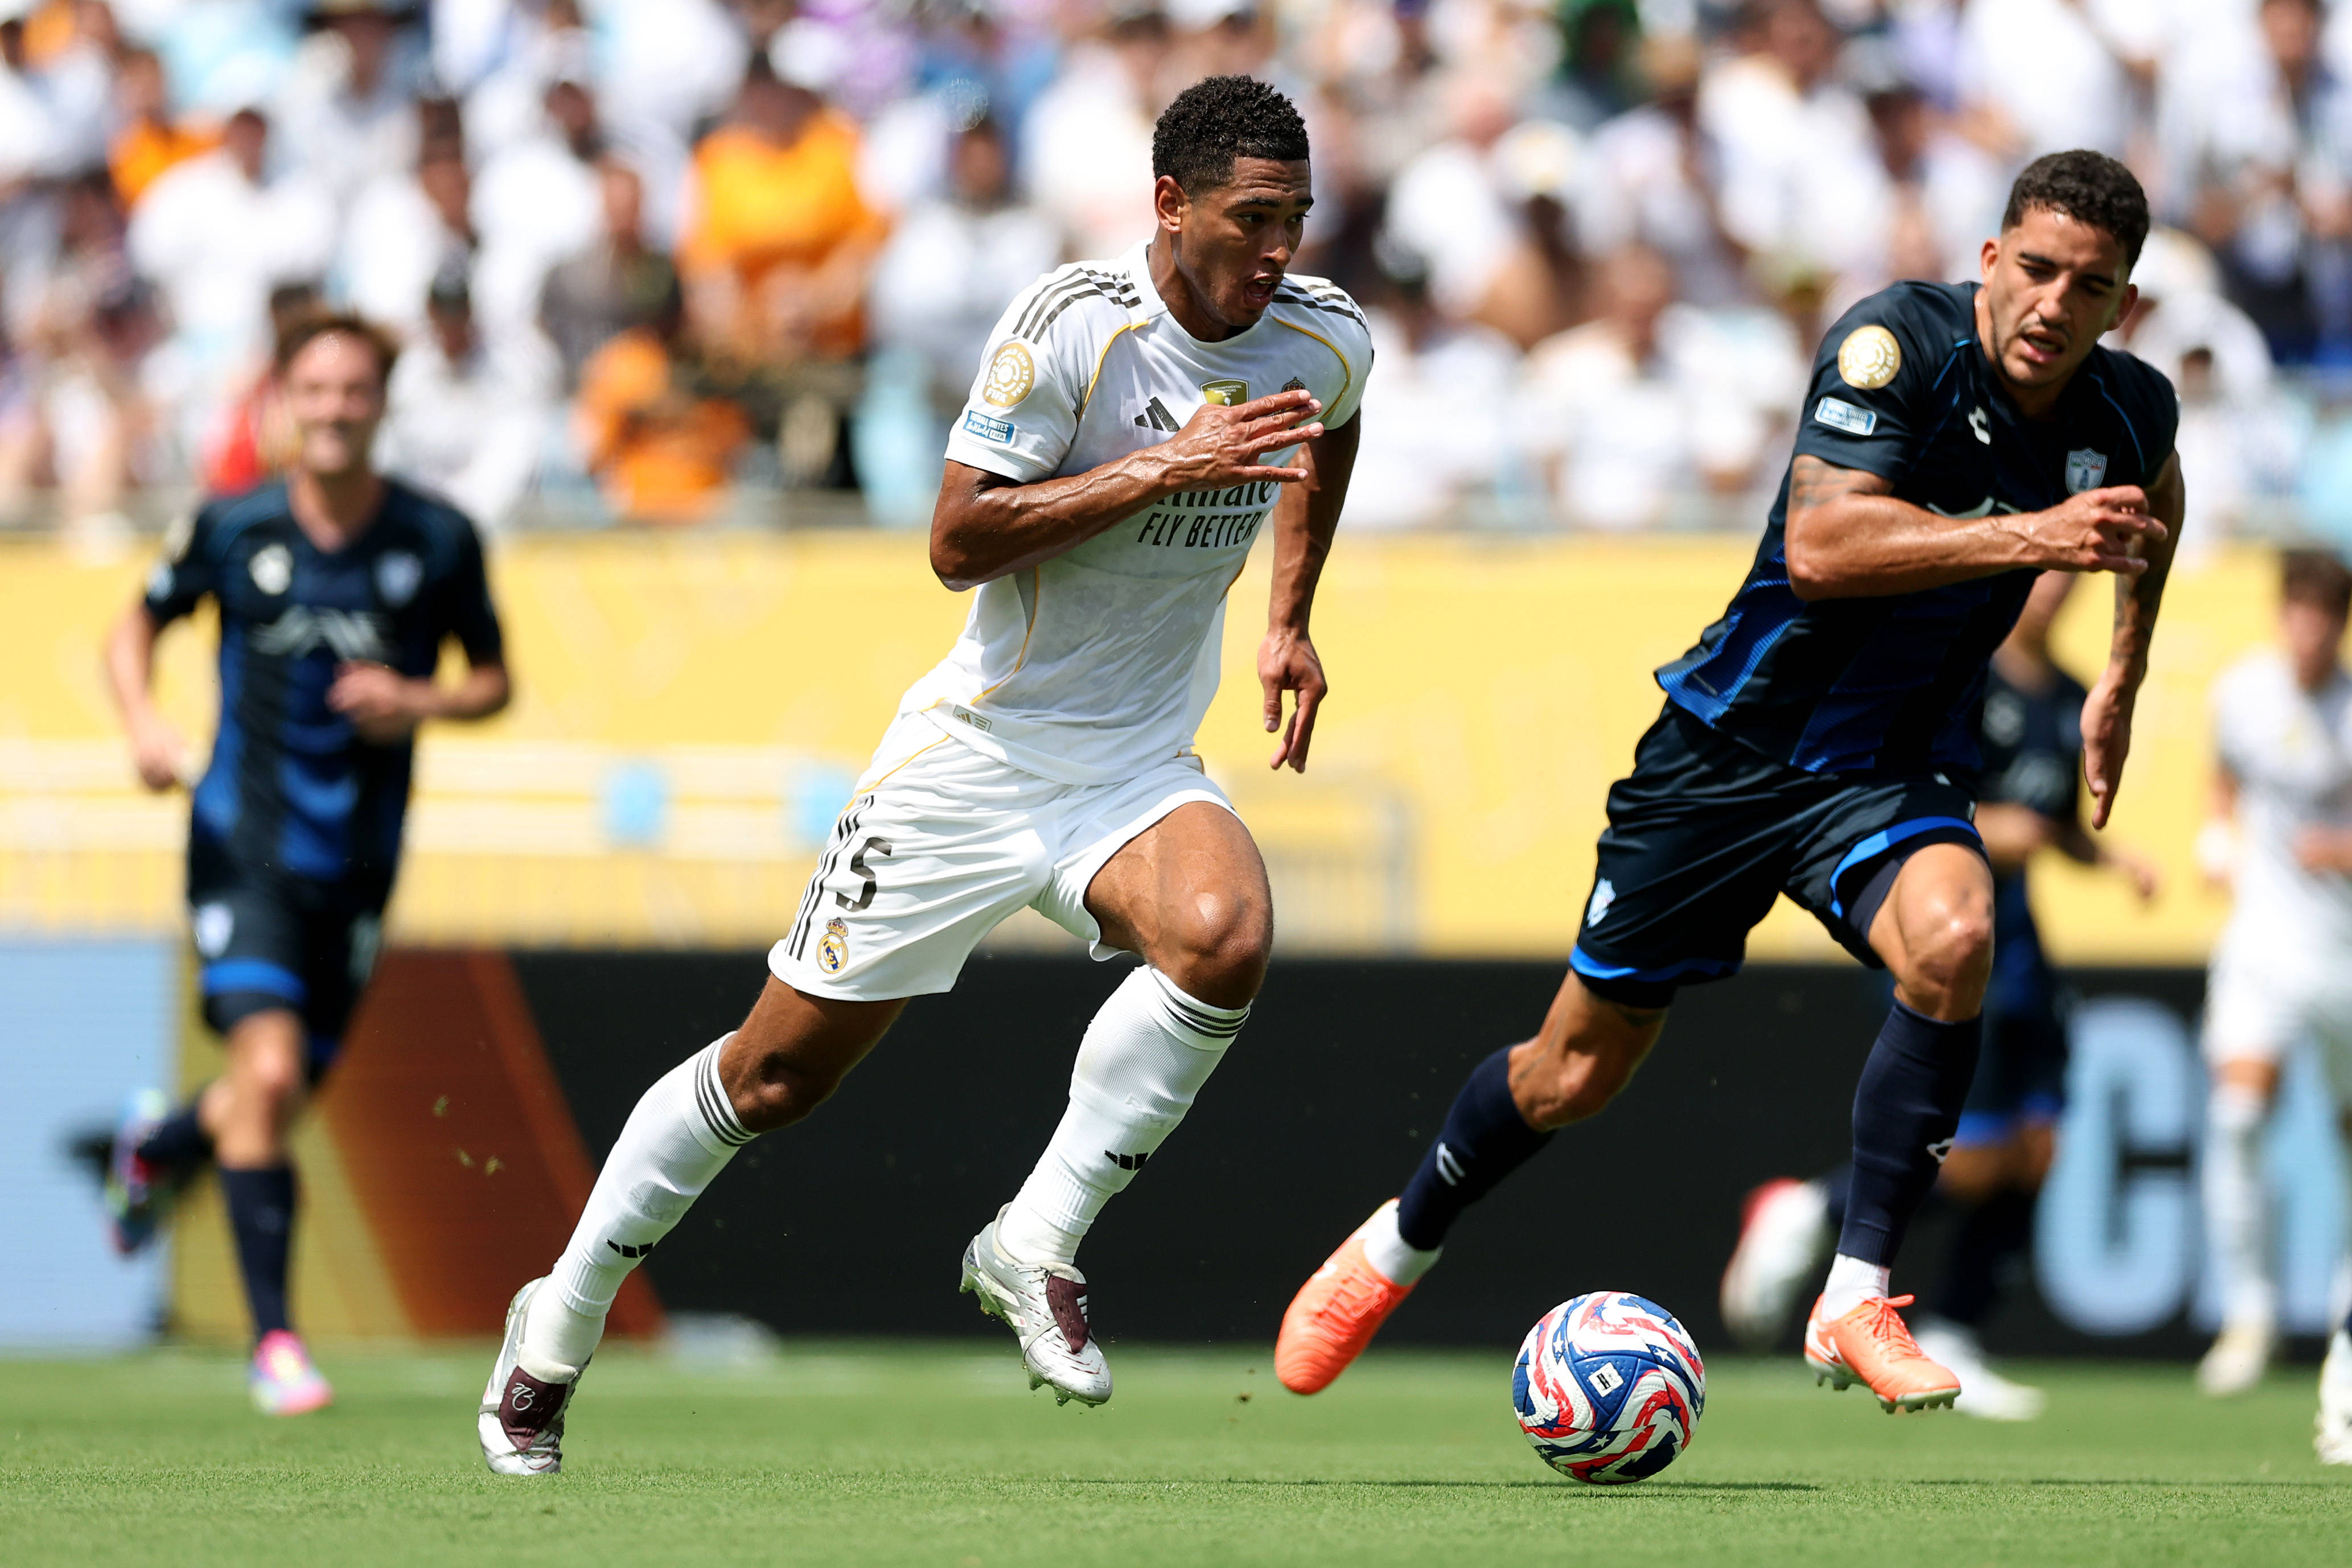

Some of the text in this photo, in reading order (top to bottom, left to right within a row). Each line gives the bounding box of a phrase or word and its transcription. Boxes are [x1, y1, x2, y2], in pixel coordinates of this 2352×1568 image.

[985, 388, 1008, 404] FIFA
[1137, 512, 1262, 548] FLY BETTER
[836, 837, 893, 912] 5
